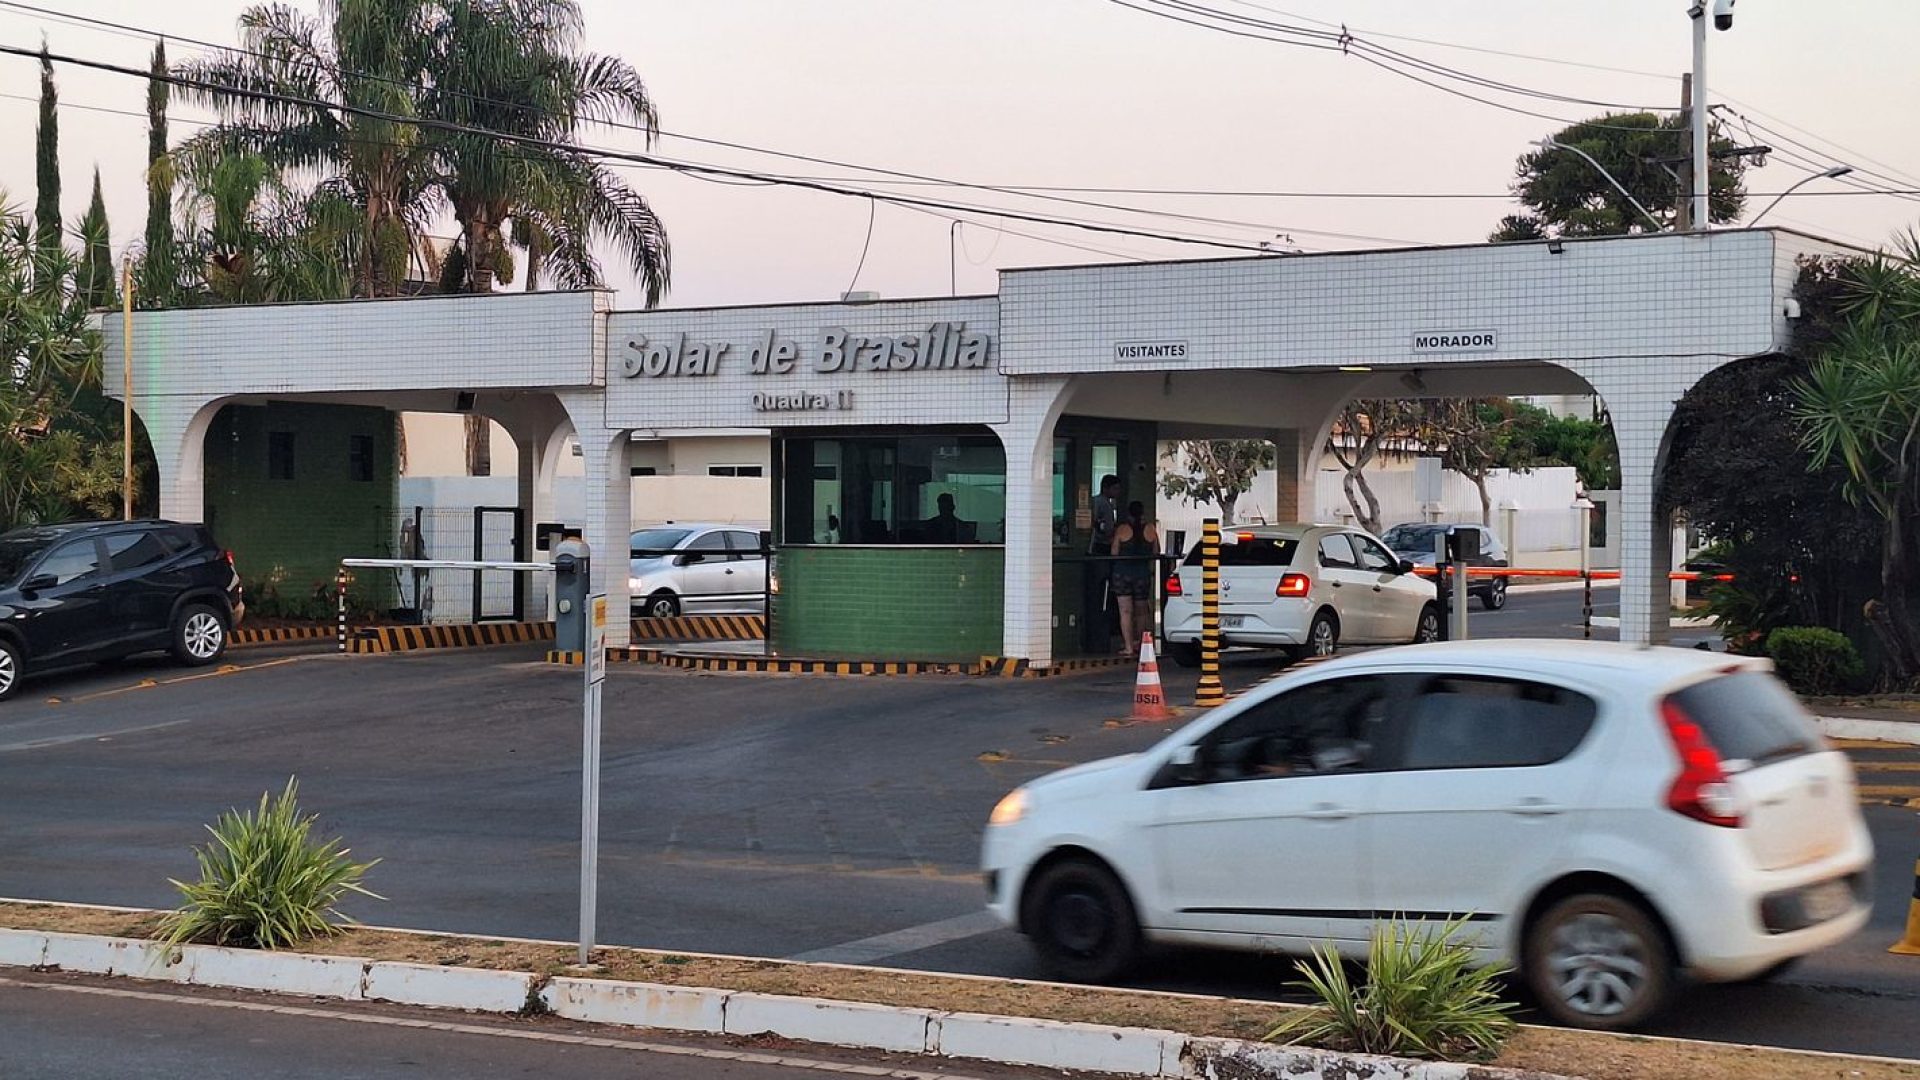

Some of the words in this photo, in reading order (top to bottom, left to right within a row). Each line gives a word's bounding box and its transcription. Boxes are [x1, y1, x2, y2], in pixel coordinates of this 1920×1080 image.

[621, 331, 730, 378] Solar
[746, 328, 799, 375] de
[815, 321, 990, 374] Brasília
[1416, 334, 1493, 348] MORADOR
[1118, 345, 1185, 358] VISITANTES
[752, 390, 830, 412] Quadra
